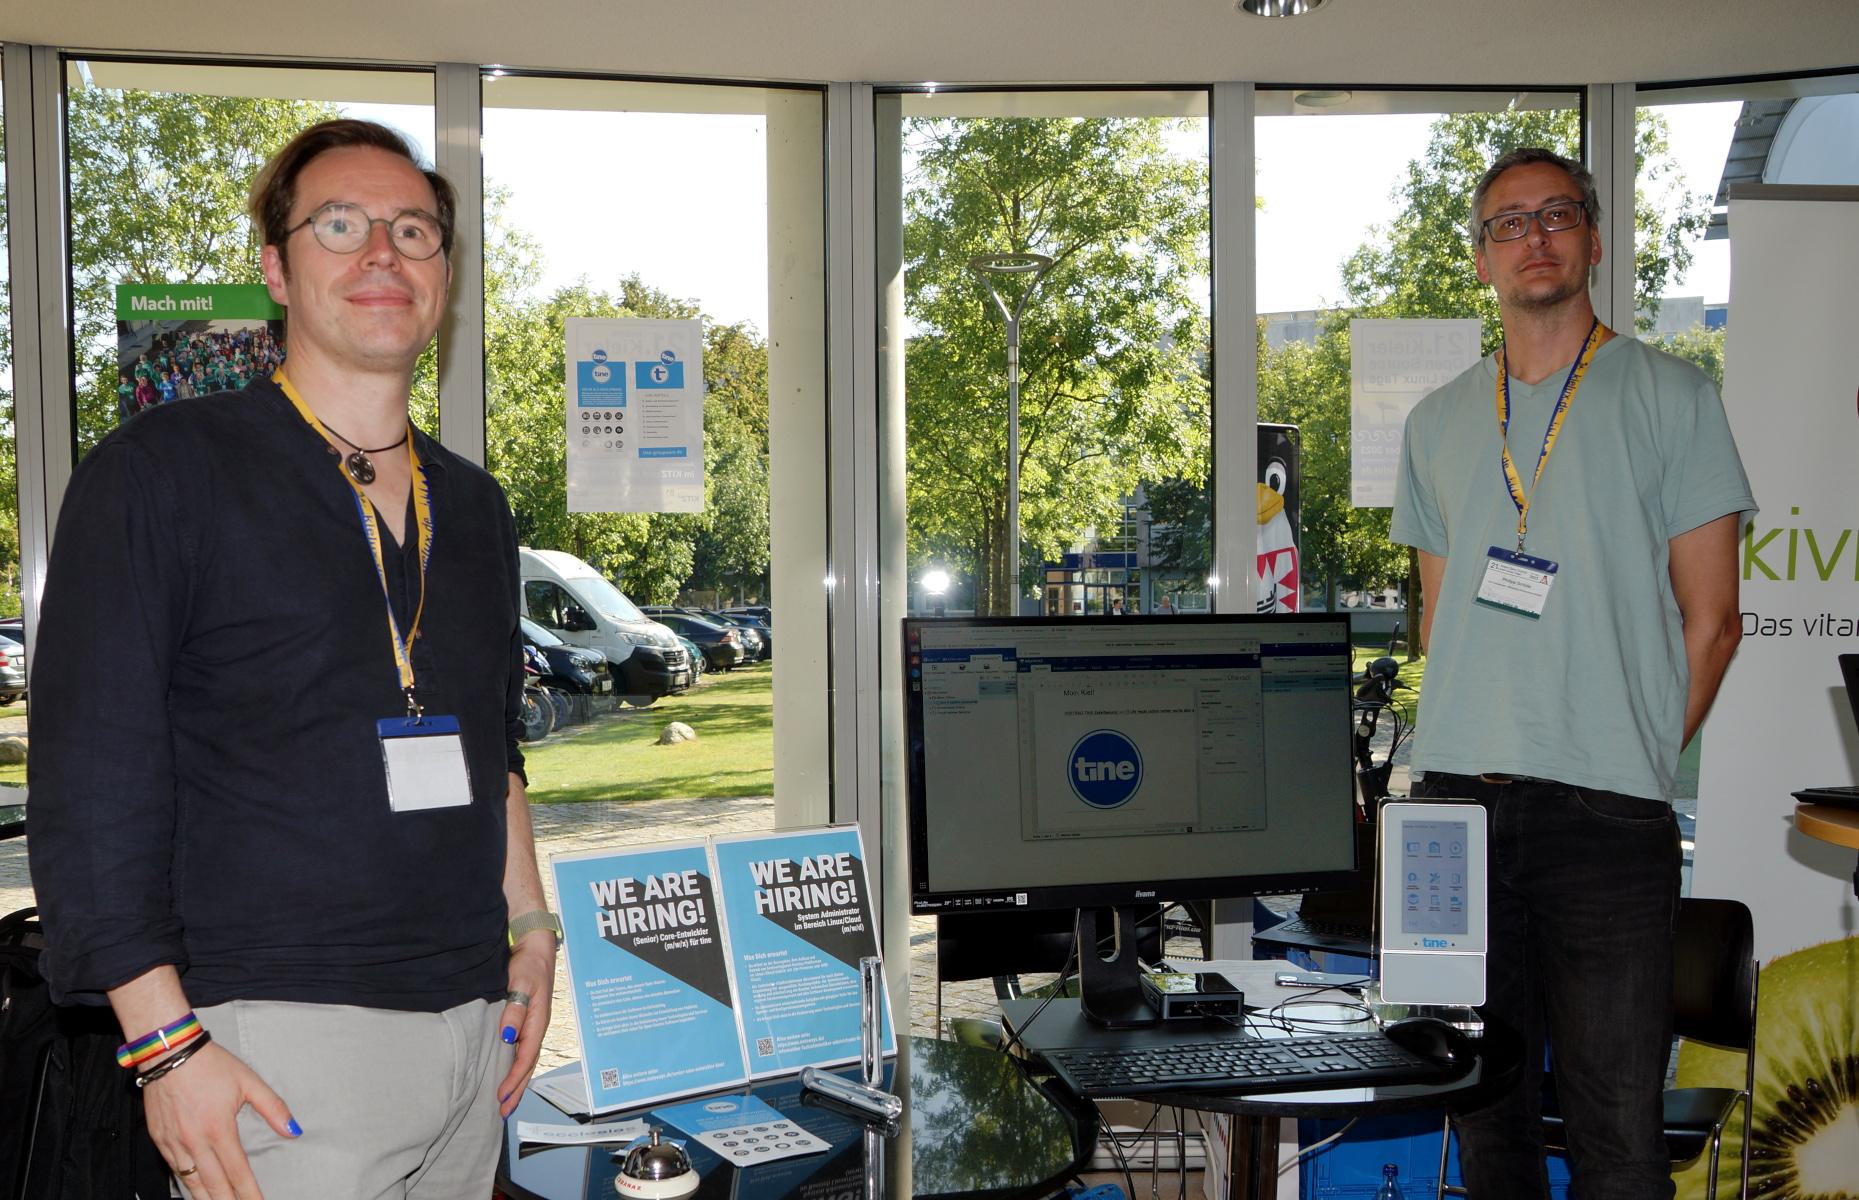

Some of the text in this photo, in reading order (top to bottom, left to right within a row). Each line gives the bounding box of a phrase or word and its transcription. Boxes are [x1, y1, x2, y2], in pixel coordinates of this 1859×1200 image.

[131, 296, 213, 311] Mach mit!
[1742, 612, 1793, 636] Das
[1074, 756, 1134, 782] tine
[748, 852, 852, 886] WE ARE
[589, 870, 701, 906] WE ARE
[754, 880, 858, 914] HIRING!
[596, 898, 706, 938] HIRING!
[798, 908, 860, 922] System Administrator
[804, 920, 826, 930] Bereich
[827, 916, 861, 926] Linux/Cloud
[633, 928, 708, 947] (Senior) Core-Entwickler
[689, 938, 700, 946] für
[700, 937, 712, 945] tine
[1422, 937, 1448, 948] tine
